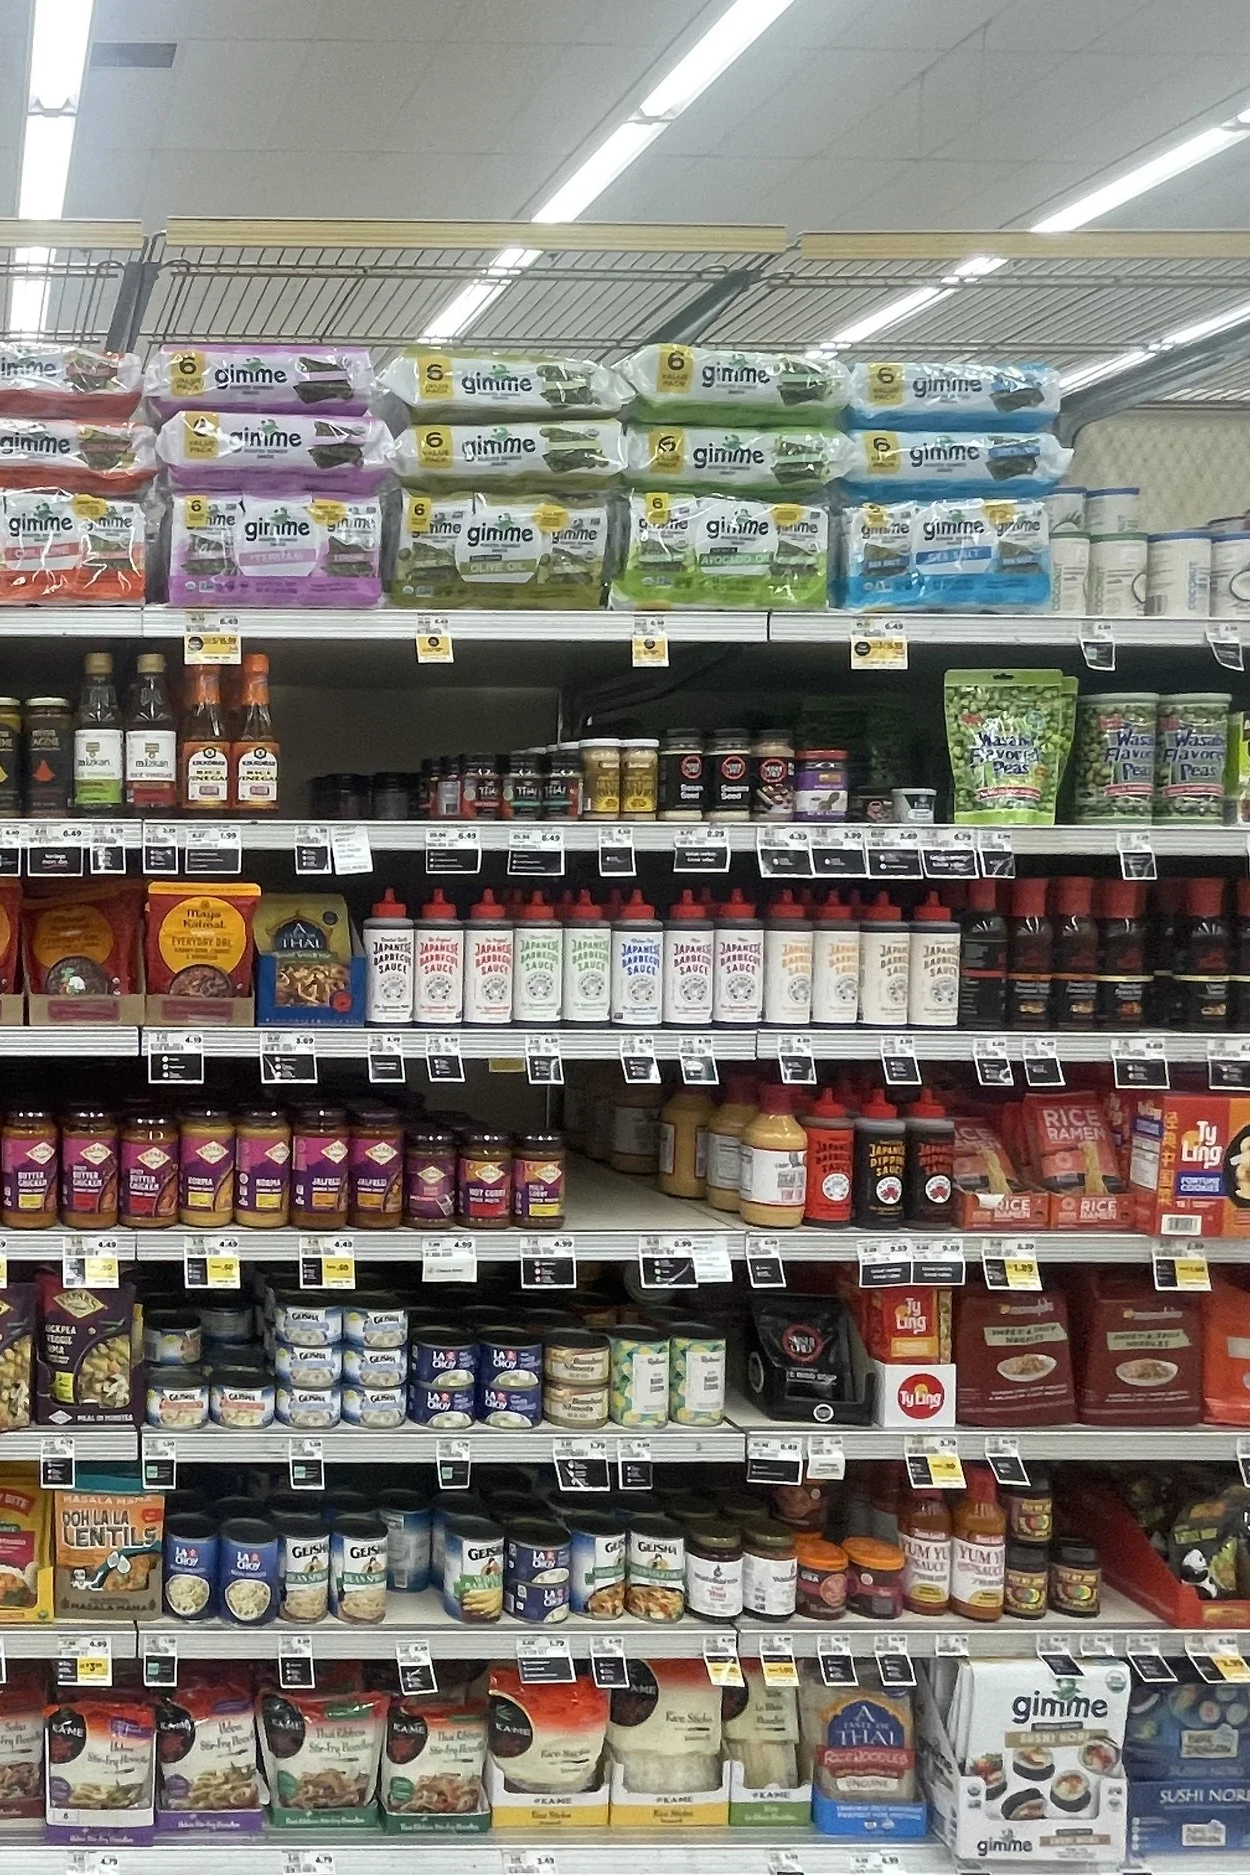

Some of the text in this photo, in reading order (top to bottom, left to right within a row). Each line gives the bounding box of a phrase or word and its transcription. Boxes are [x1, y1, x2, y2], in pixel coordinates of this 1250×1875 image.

[426, 364, 444, 382] 6
[667, 355, 685, 371] 6
[215, 364, 287, 389] gimme
[462, 373, 532, 395] gimme
[702, 364, 770, 386] gimme
[913, 374, 982, 397] gimme
[0, 432, 70, 454] gimme
[426, 431, 443, 449] 6
[694, 443, 765, 467] gimme
[910, 443, 980, 466] gimme
[414, 503, 425, 516] 6
[9, 513, 73, 536] gimme
[923, 518, 985, 539] gimme
[467, 523, 534, 547] gimme
[1044, 1109, 1102, 1127] RICE
[1046, 1126, 1106, 1141] RAMEN
[1198, 1121, 1217, 1146] Ty
[1182, 1146, 1221, 1169] Ling
[1081, 1199, 1116, 1210] RICE
[906, 1298, 921, 1315] Ty
[896, 1315, 926, 1334] Ling
[900, 1390, 942, 1409] Ty Ling
[93, 1512, 108, 1524] LA
[113, 1511, 129, 1524] LA
[63, 1527, 156, 1547] LENTILS
[175, 1547, 188, 1558] LA
[1013, 1689, 1109, 1723] gimme
[837, 1730, 895, 1746] THAI
[1160, 1789, 1205, 1804] SUSHI
[978, 1836, 1032, 1856] gimme
